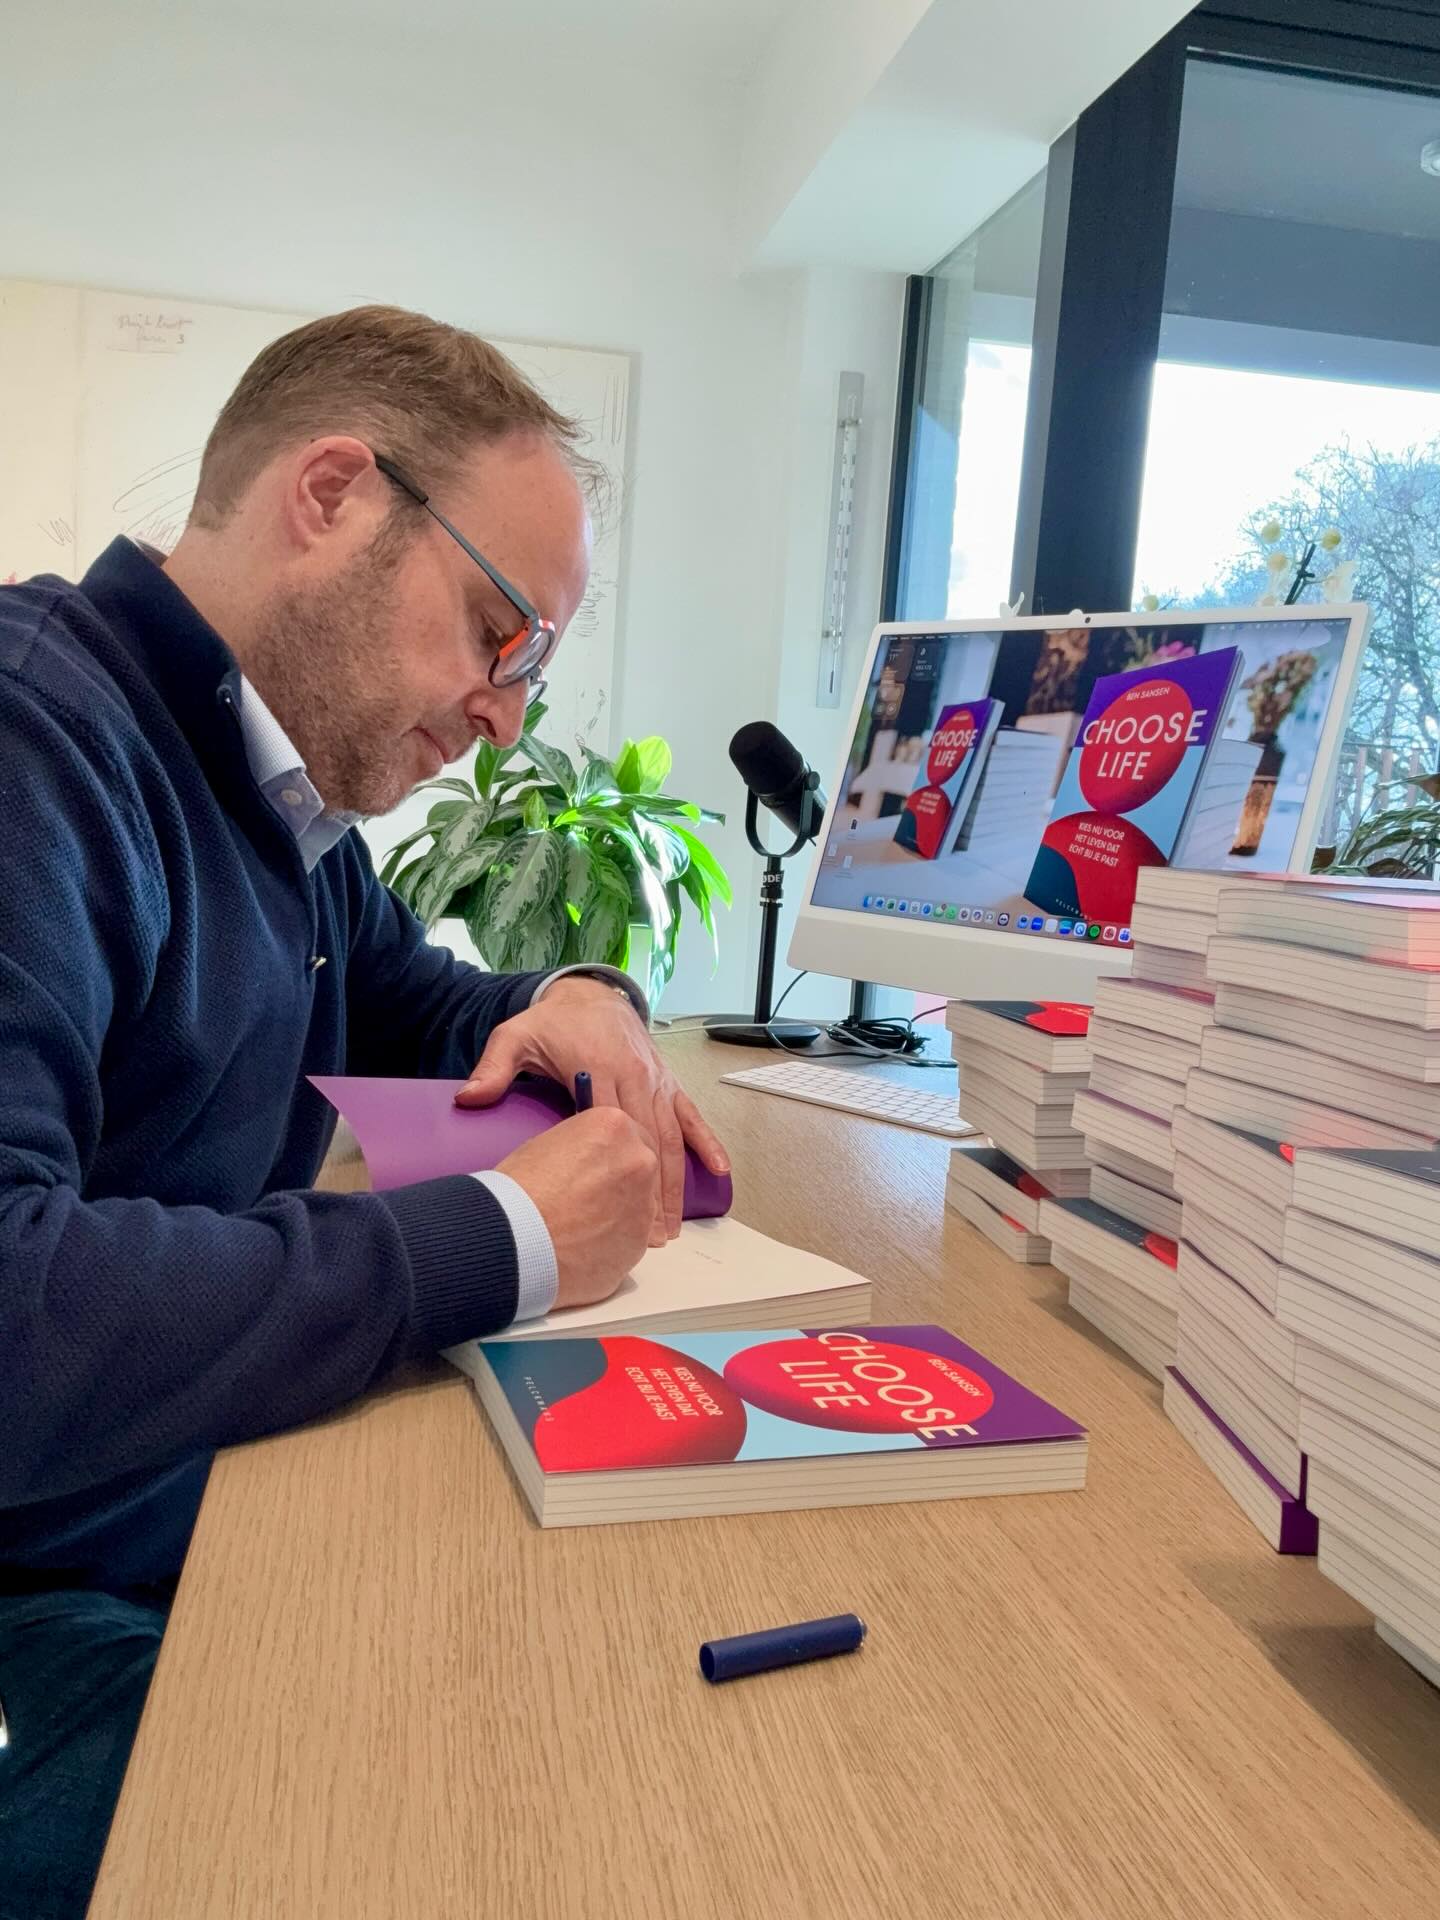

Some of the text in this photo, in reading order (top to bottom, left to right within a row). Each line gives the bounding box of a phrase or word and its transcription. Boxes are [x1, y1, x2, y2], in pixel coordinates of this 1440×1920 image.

[1140, 687, 1171, 699] SANSEN
[931, 729, 978, 747] CHOOSE
[1083, 709, 1208, 745] CHOOSE
[934, 750, 958, 767] LIFE
[1097, 751, 1152, 780] LIFE
[1075, 833, 1121, 854] HET LEVEN DAT
[1078, 822, 1125, 841] KIES NU VOOR
[1069, 844, 1085, 855] ECHT
[1100, 854, 1119, 867] PAST
[649, 1368, 699, 1416] HET LEVEN DAT
[672, 1367, 724, 1416] KIES NU VOOR
[779, 1361, 871, 1408] LIFE
[817, 1332, 979, 1439] CHOOSE
[928, 1359, 984, 1396] BEN SANSEN
[625, 1367, 677, 1421] ECHT BIJ JE PAST
